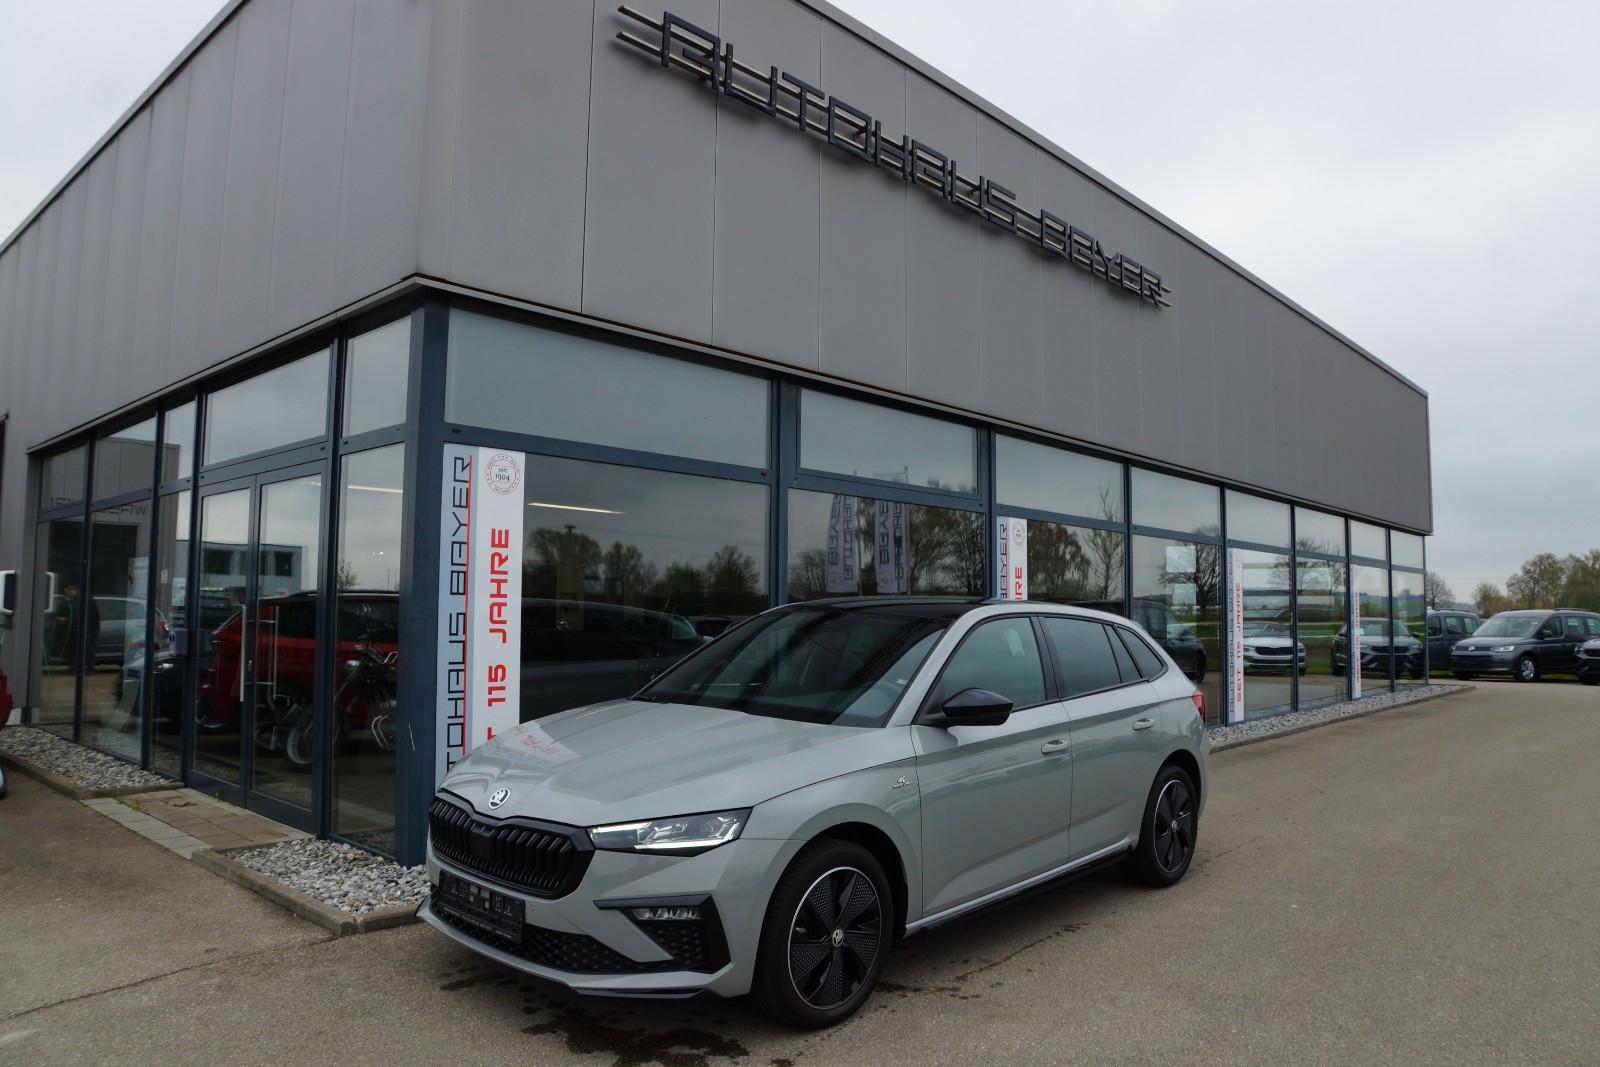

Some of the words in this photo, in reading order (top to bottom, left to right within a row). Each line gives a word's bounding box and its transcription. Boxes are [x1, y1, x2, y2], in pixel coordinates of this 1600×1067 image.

[661, 11, 1017, 234] AUTOHAUS
[1040, 208, 1163, 306] BAYER
[450, 456, 471, 596] BAYER
[495, 474, 510, 482] 1904
[488, 528, 510, 644] JAHRE
[487, 664, 507, 707] 115
